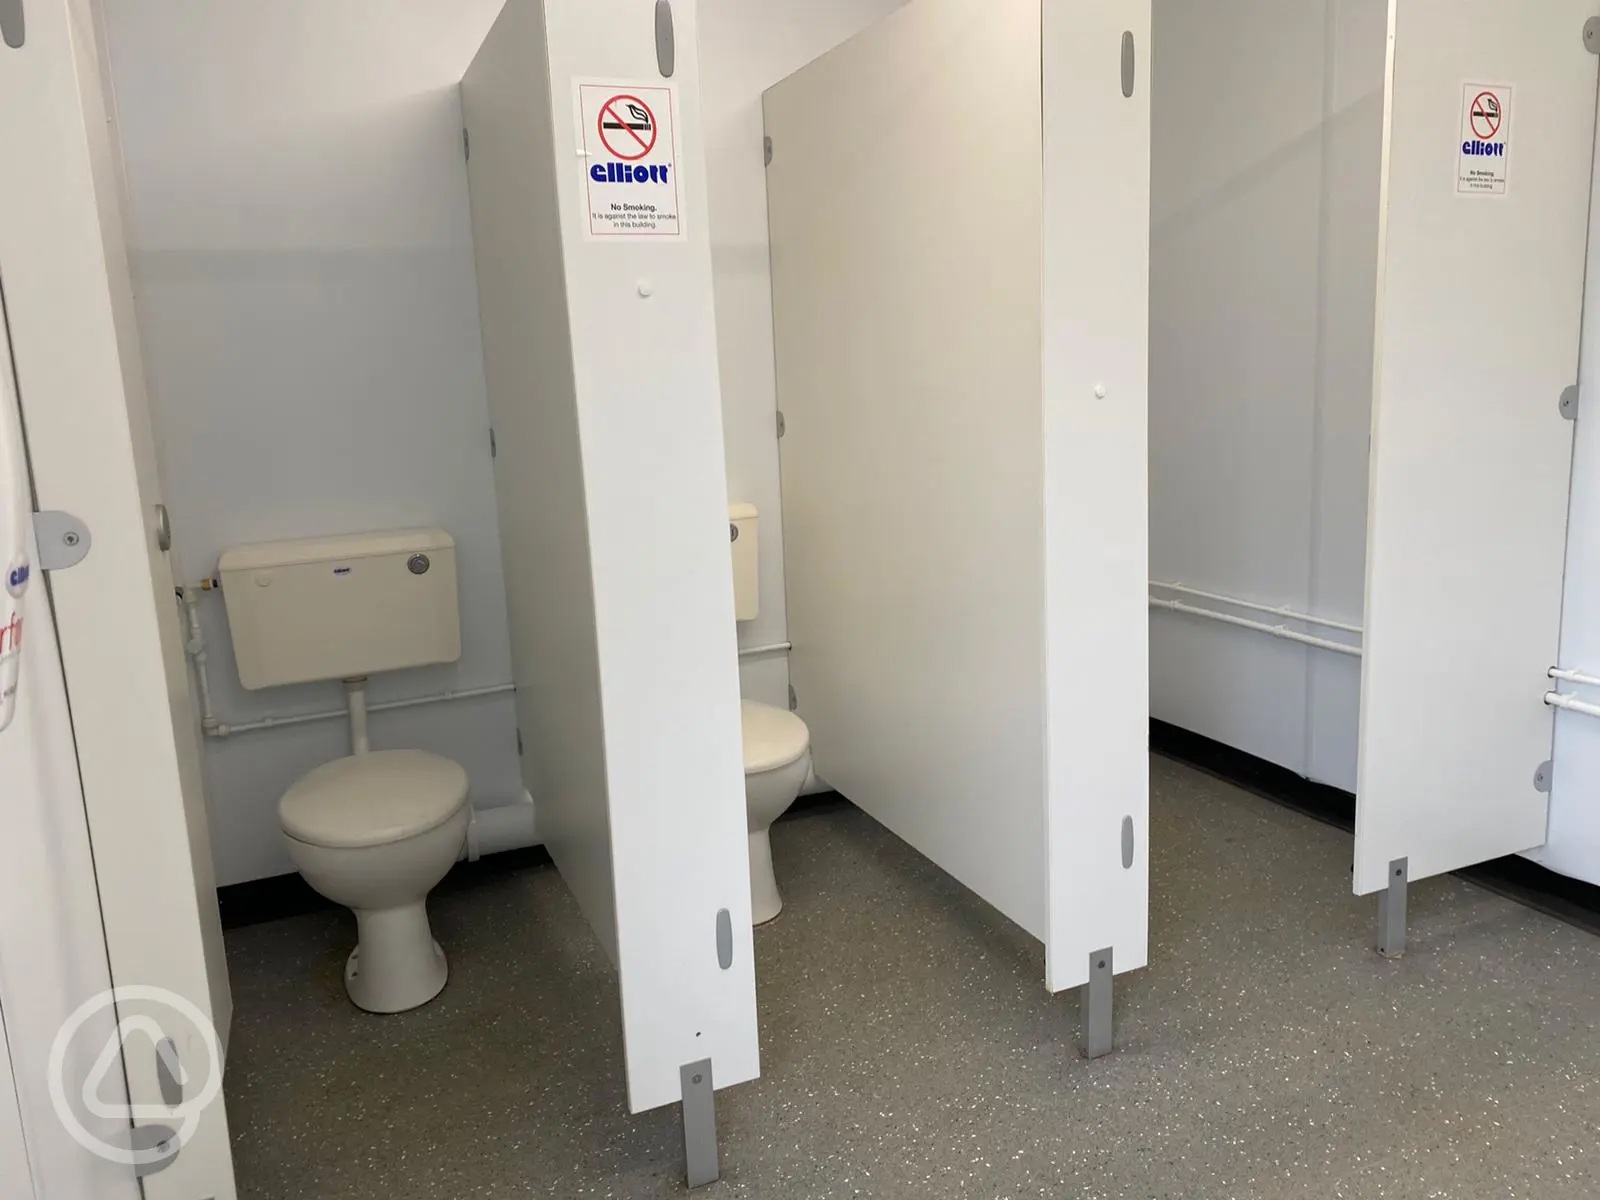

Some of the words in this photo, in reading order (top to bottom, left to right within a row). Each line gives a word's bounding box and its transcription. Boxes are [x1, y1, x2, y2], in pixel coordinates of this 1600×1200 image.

[1462, 140, 1504, 156] elliott
[590, 162, 669, 184] elliott
[610, 203, 622, 211] No
[623, 203, 657, 212] Smoking.
